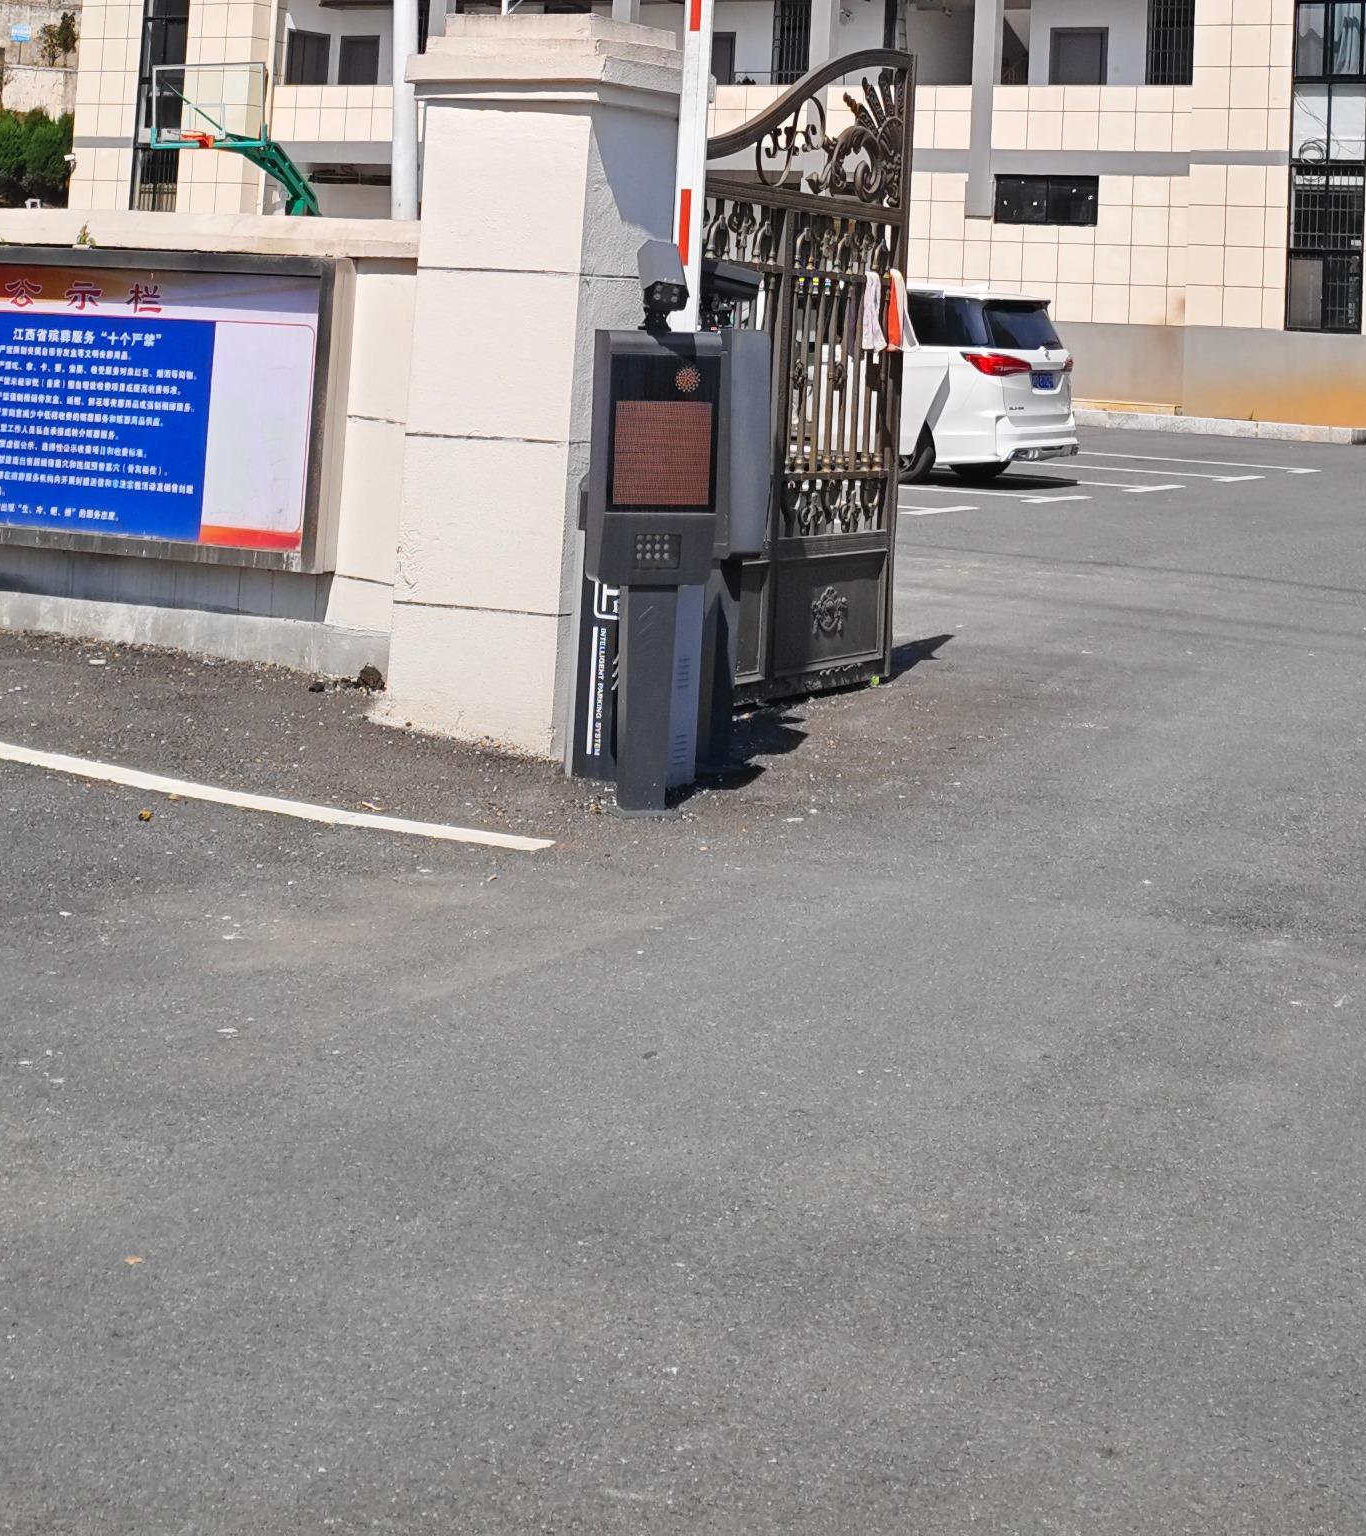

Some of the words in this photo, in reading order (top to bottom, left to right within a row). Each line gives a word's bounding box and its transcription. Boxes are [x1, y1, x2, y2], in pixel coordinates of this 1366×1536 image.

[4, 278, 164, 314] 公示栏
[597, 627, 607, 680] INTELLIGENT
[595, 682, 605, 719] PARKING
[593, 723, 602, 756] SYSTEM
